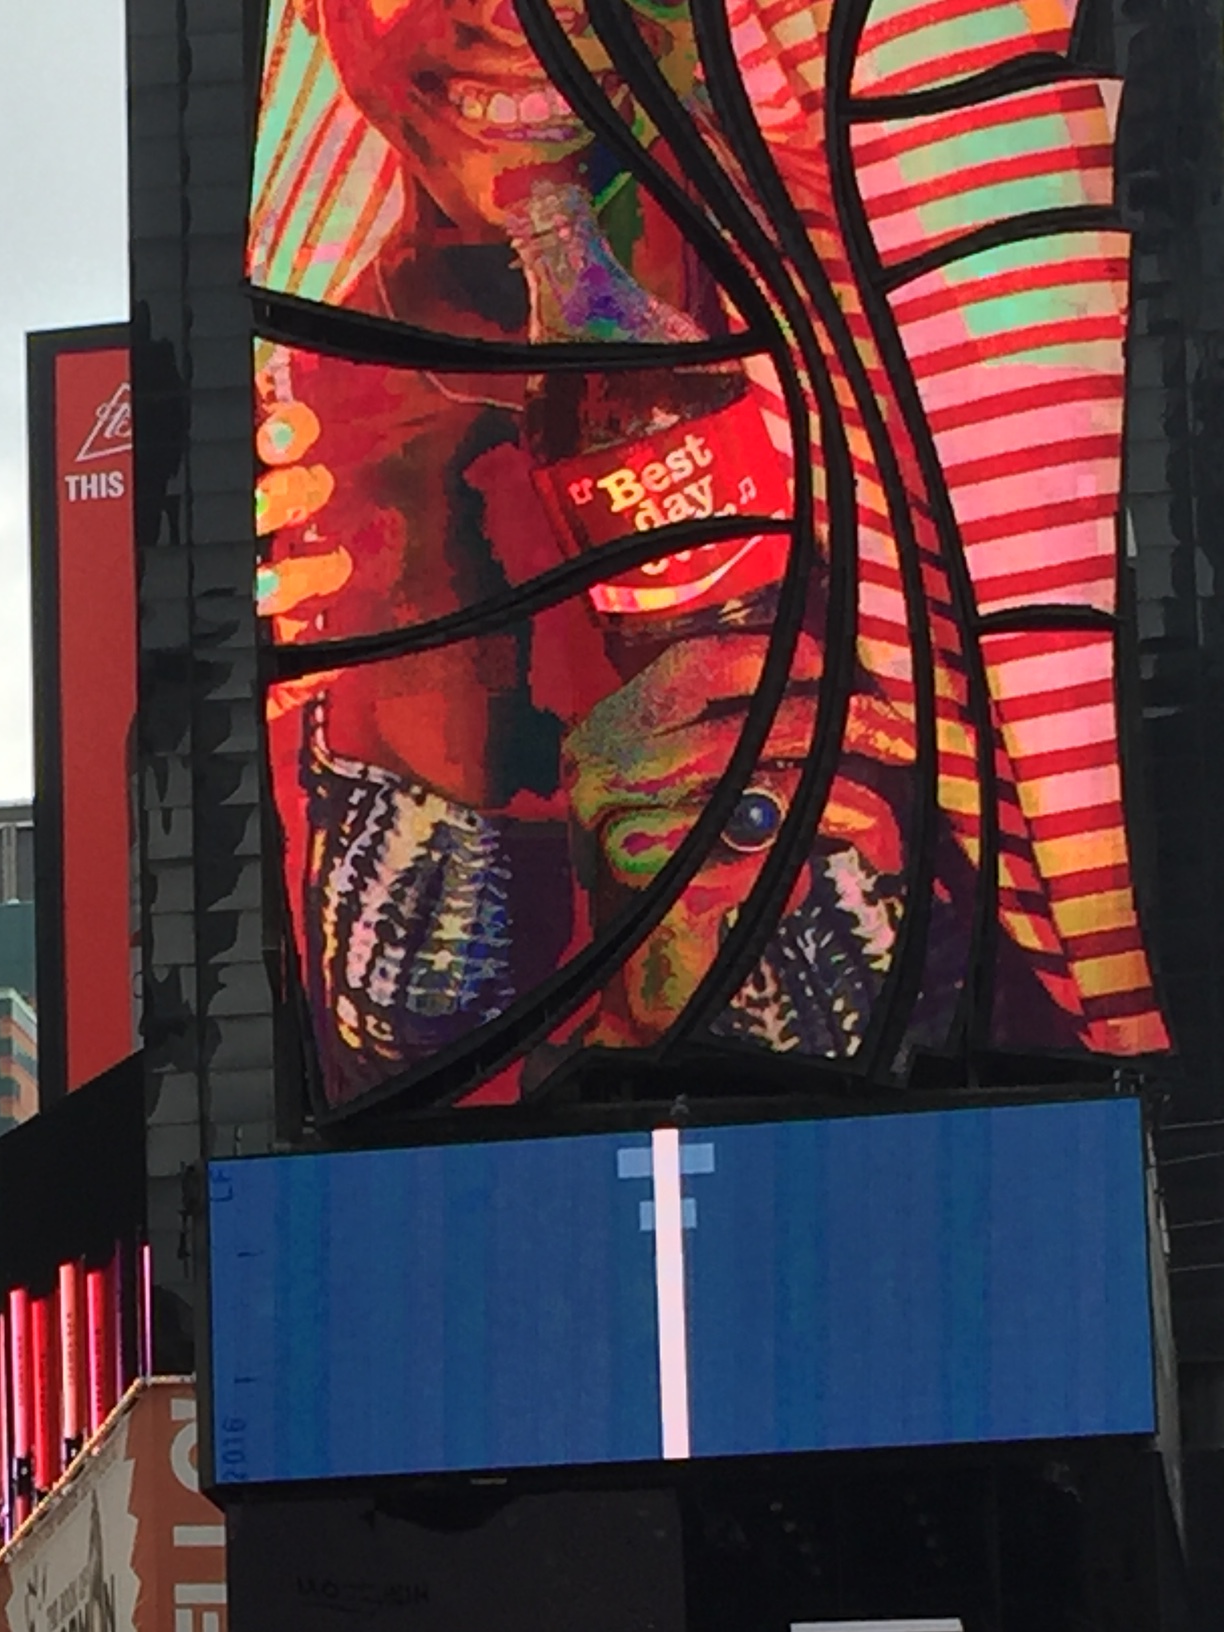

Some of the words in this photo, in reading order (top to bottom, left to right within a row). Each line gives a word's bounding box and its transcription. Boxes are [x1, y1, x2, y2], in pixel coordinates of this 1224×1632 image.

[64, 470, 125, 502] THIS
[596, 433, 715, 514] Best
[634, 474, 715, 532] day
